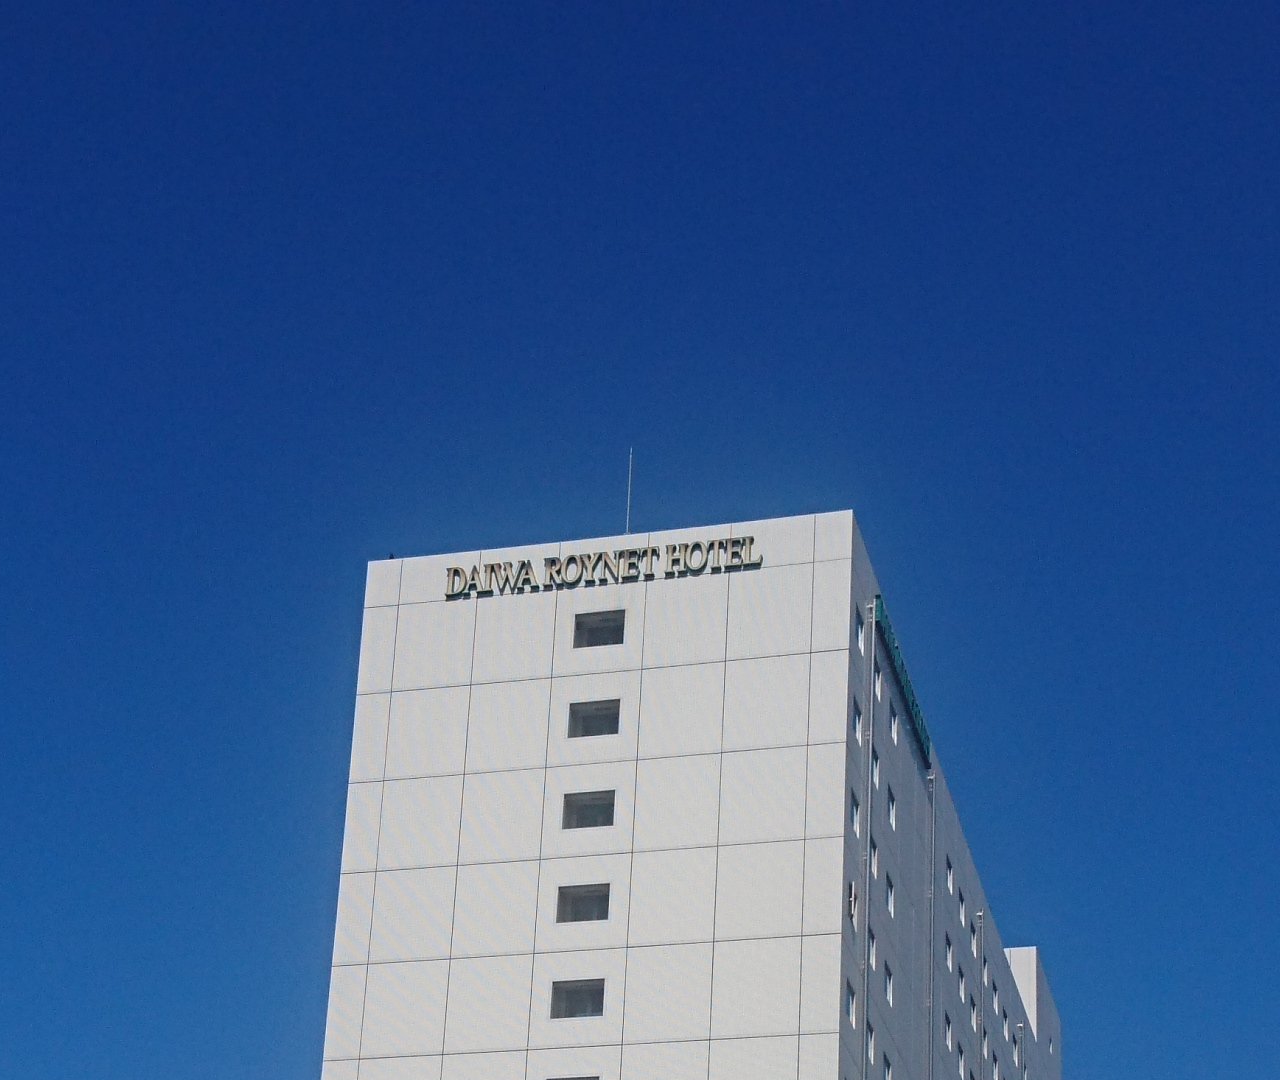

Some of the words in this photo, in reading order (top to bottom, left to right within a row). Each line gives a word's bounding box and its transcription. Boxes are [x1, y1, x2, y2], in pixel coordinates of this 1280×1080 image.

[445, 559, 540, 602] DAIWA
[543, 546, 660, 591] ROYNET
[664, 536, 764, 579] HOTEL
